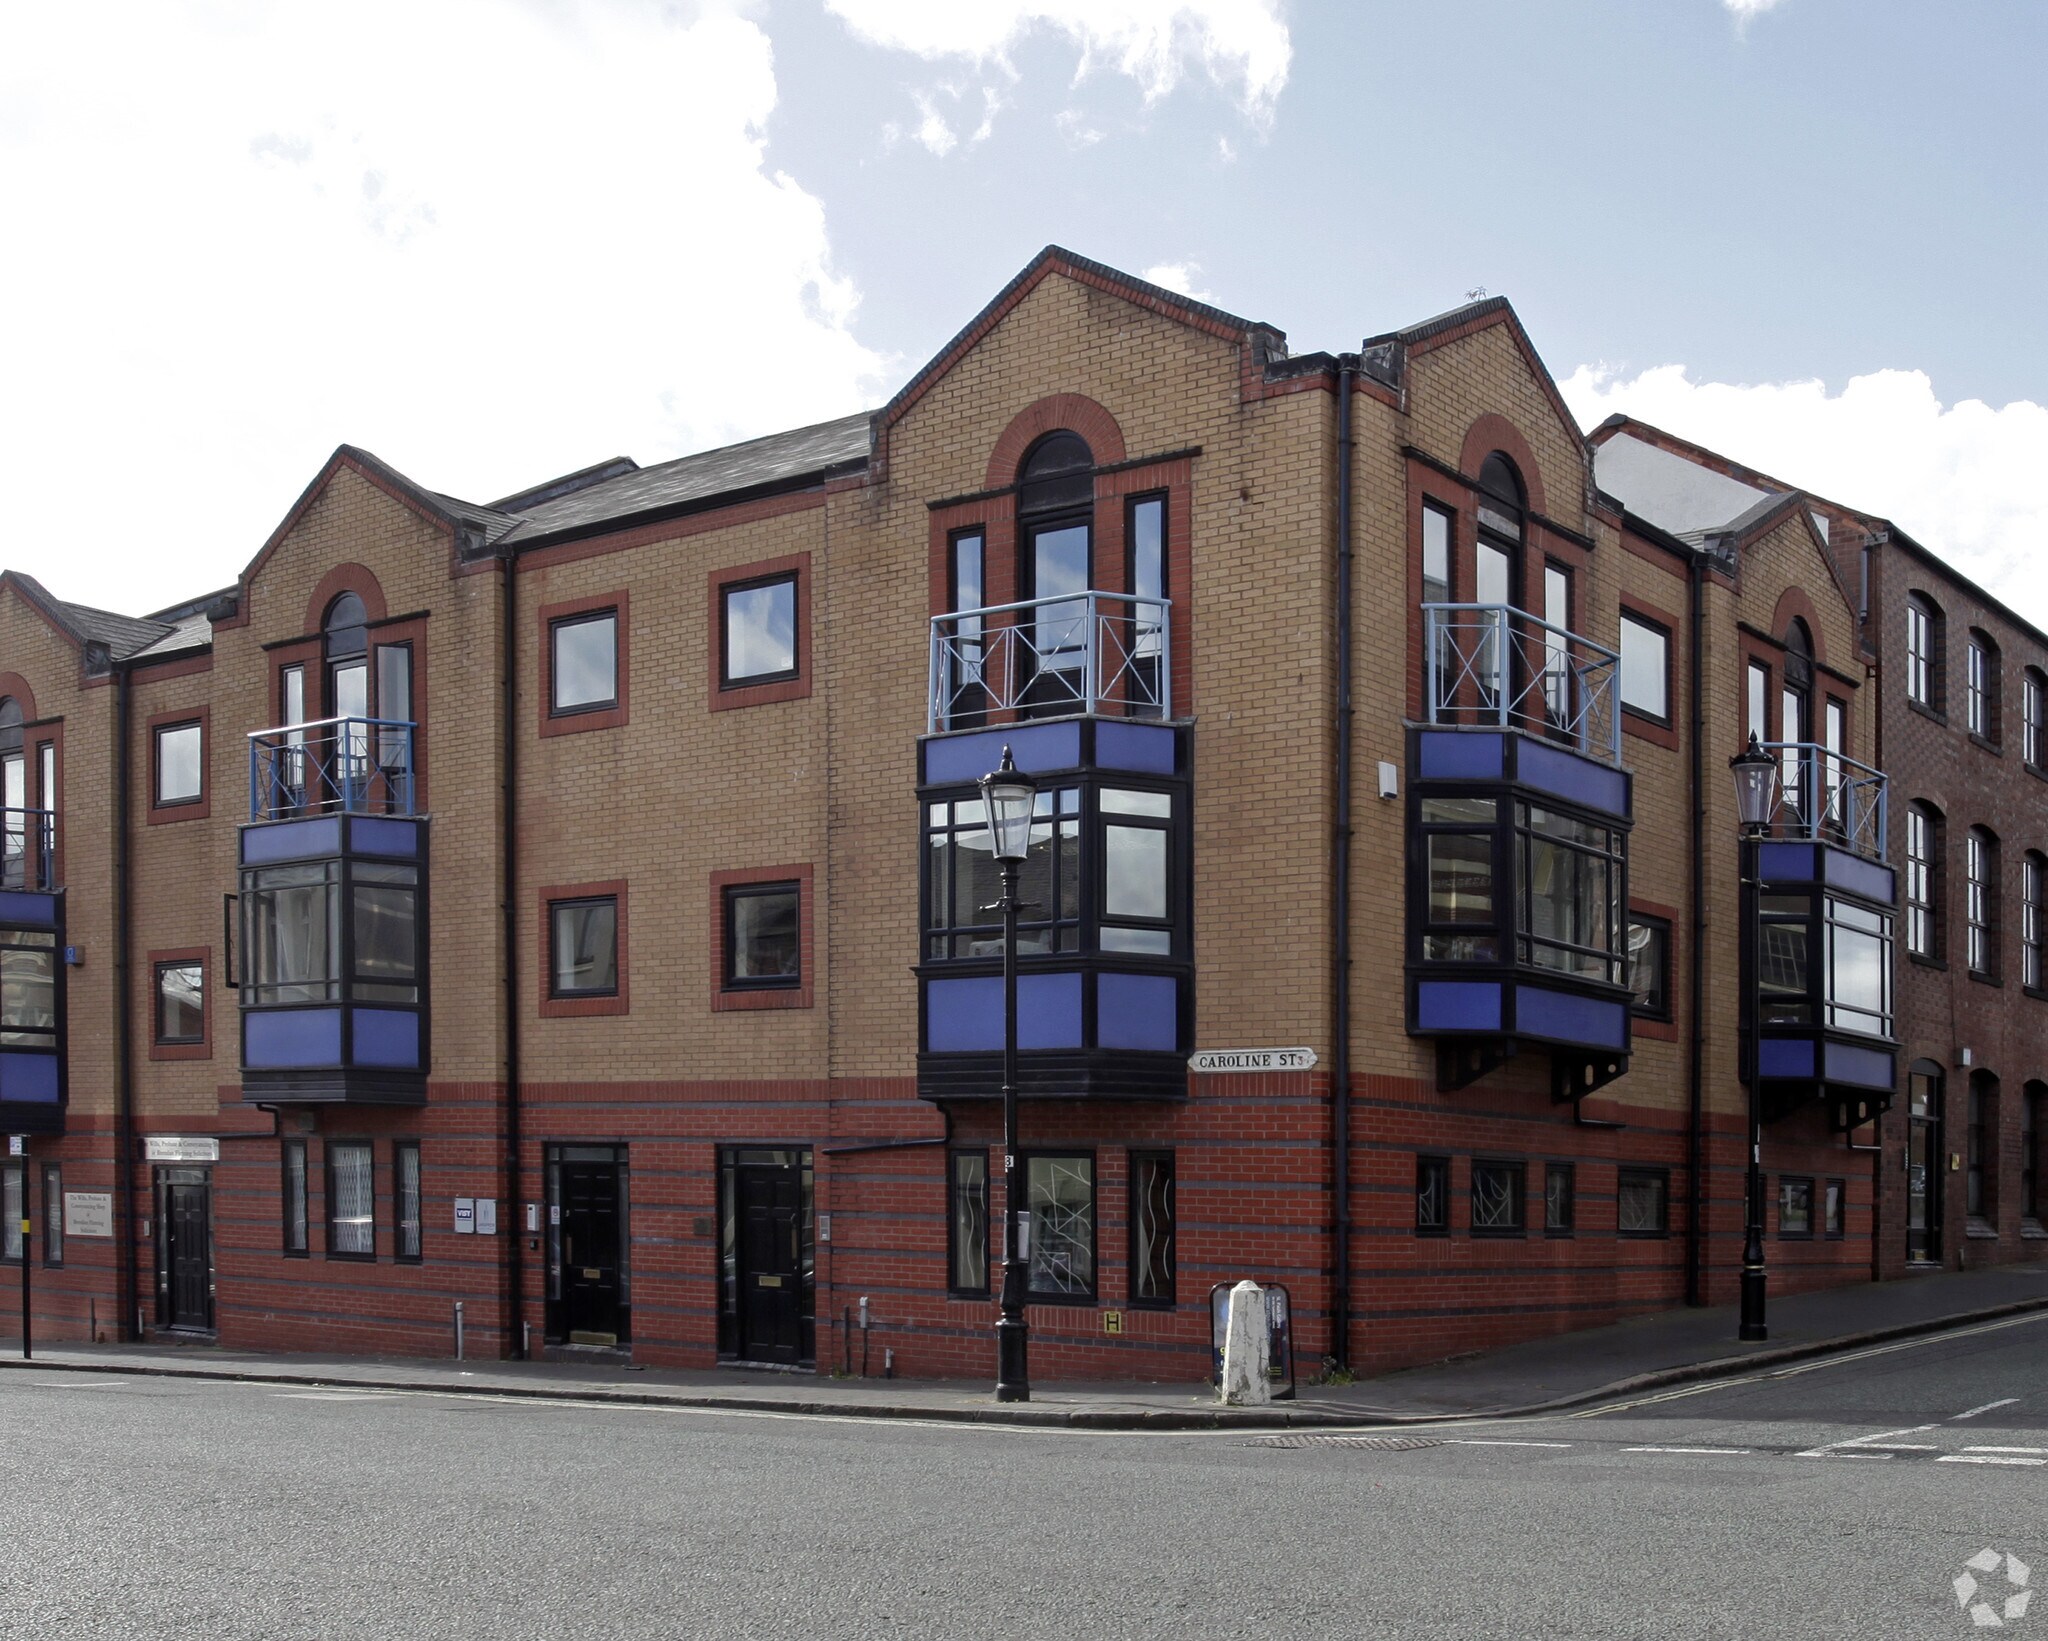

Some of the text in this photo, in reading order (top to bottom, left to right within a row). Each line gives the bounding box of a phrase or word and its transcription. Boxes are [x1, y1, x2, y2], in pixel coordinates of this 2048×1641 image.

[1199, 1055, 1271, 1068] CAROLINE
[1279, 1053, 1297, 1066] ST
[1106, 1313, 1119, 1331] H
